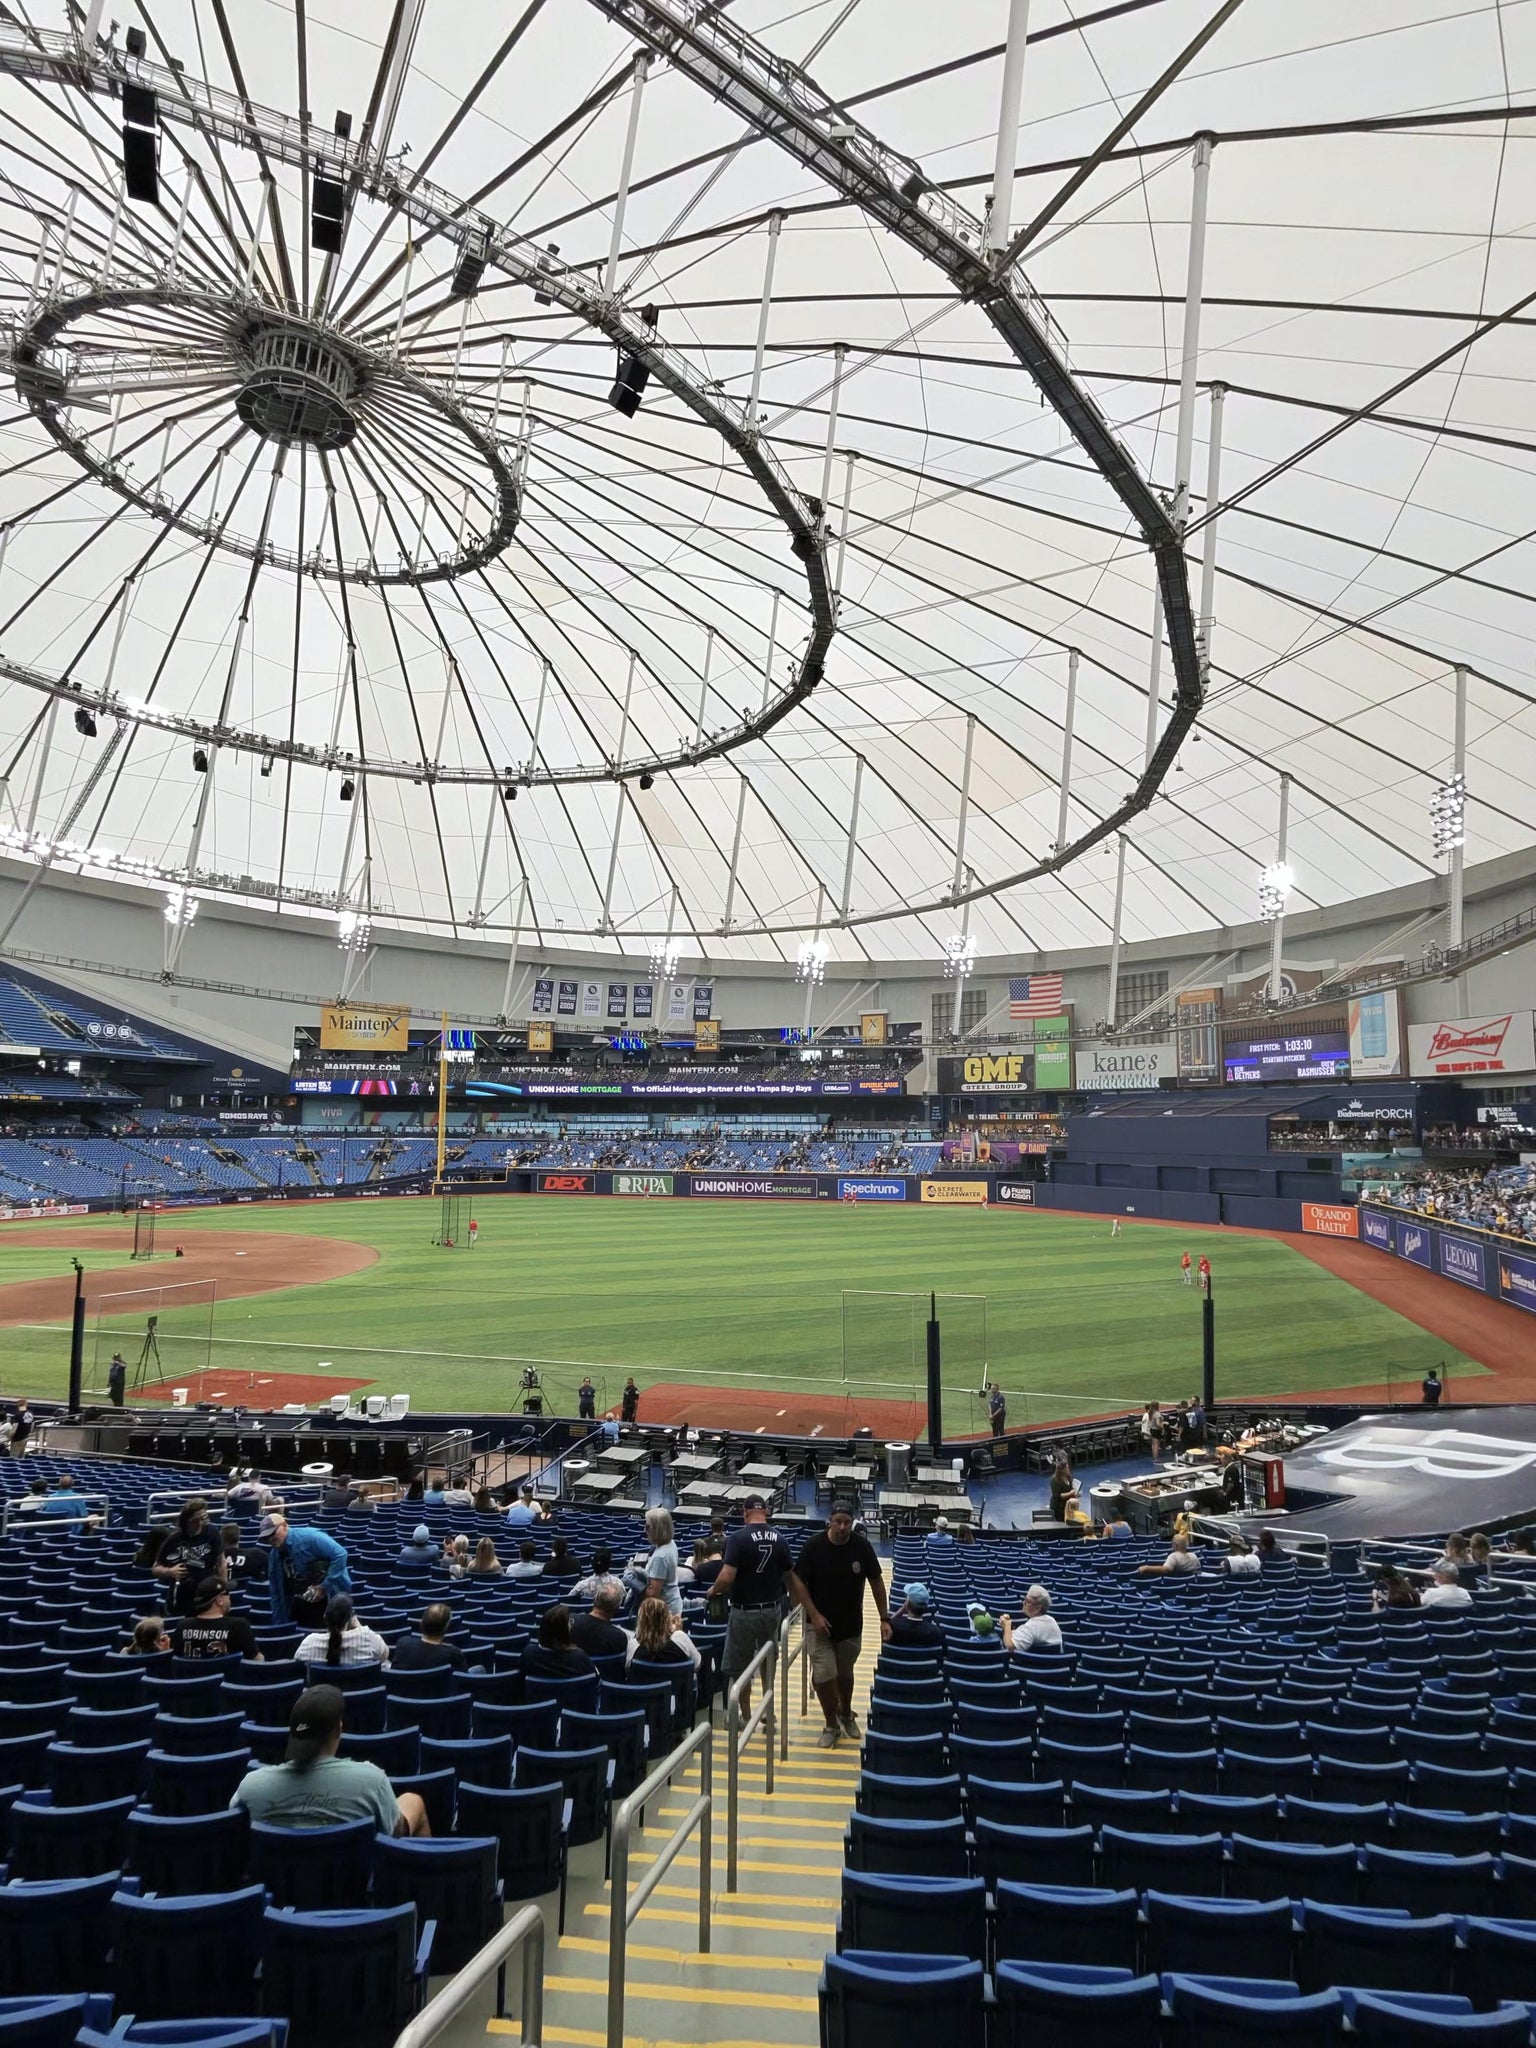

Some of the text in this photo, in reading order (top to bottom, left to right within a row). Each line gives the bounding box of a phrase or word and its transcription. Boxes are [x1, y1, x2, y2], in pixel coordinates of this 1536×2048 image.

[329, 1015, 401, 1038] MaintenX
[1264, 1043, 1280, 1051] PITCH:
[1284, 1039, 1312, 1052] 1:03:10
[1433, 1032, 1503, 1050] Budweiser
[1092, 1052, 1158, 1072] kane's
[1284, 1054, 1305, 1062] PITCHERS
[964, 1056, 1024, 1082] GMF
[1298, 1067, 1335, 1077] RASMUSSEN
[1234, 1071, 1260, 1080] DETMERS
[781, 1086, 794, 1094] Bay
[796, 1086, 812, 1094] Rays
[321, 1108, 342, 1117] VIVA
[1337, 1109, 1413, 1119] Budweiser PORCH
[544, 1176, 588, 1190] DEX
[632, 1178, 667, 1193] RIPA
[843, 1183, 894, 1195] Spectrum
[1445, 1243, 1478, 1272] LECOM
[764, 1531, 778, 1543] KIM
[758, 1544, 773, 1573] 7
[182, 1629, 230, 1640] ROBINSON
